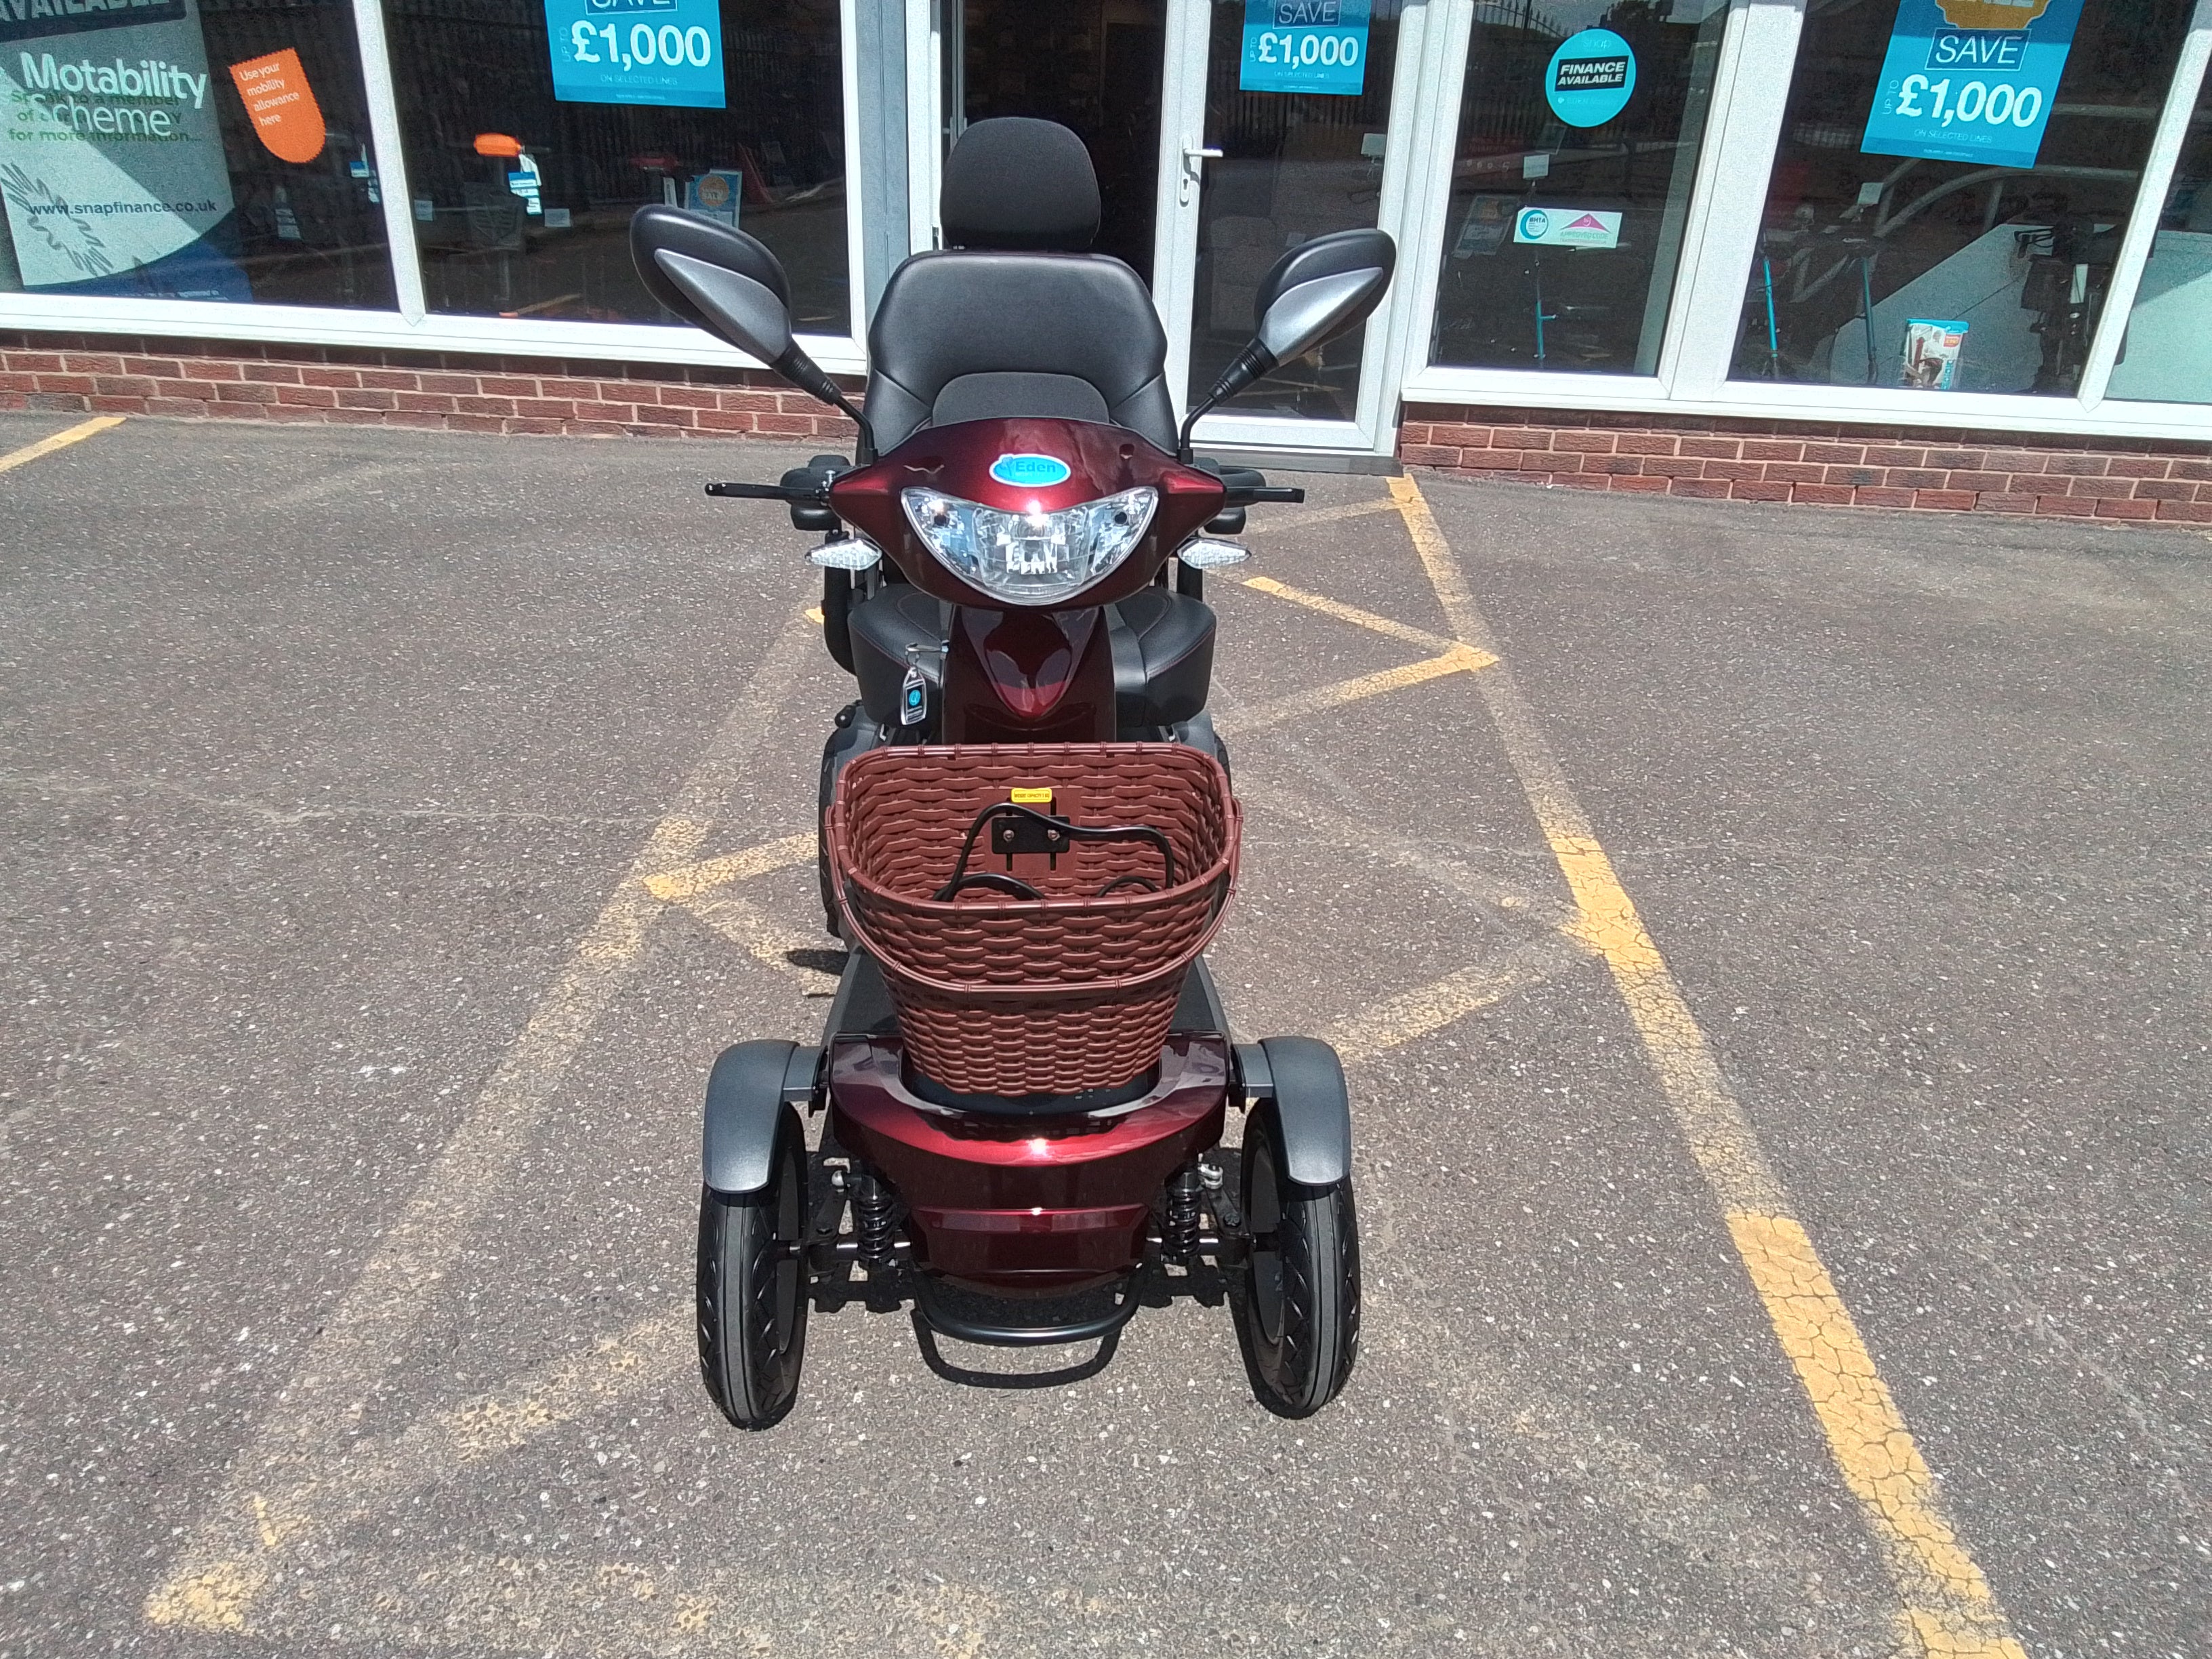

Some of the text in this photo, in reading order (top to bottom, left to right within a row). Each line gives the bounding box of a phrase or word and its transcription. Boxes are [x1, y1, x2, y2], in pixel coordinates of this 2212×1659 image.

[1279, 1, 1336, 24] SAVE
[571, 20, 711, 71] £1,000
[1258, 32, 1359, 69] £1,000
[1936, 35, 2024, 64] SAVE
[239, 62, 280, 81] Use your
[1560, 62, 1626, 75] FINANCE
[20, 52, 207, 109] Motability
[247, 79, 285, 96] mobility
[1557, 73, 1624, 85] AVAILABLE
[253, 91, 300, 111] allowance
[1896, 74, 2043, 127] £1,000
[30, 94, 170, 136] Scheme
[258, 114, 281, 126] here
[1928, 130, 1969, 141] SELECTED
[30, 199, 218, 216] www.snapfinance.co.uk
[1015, 461, 1057, 472] Eden
